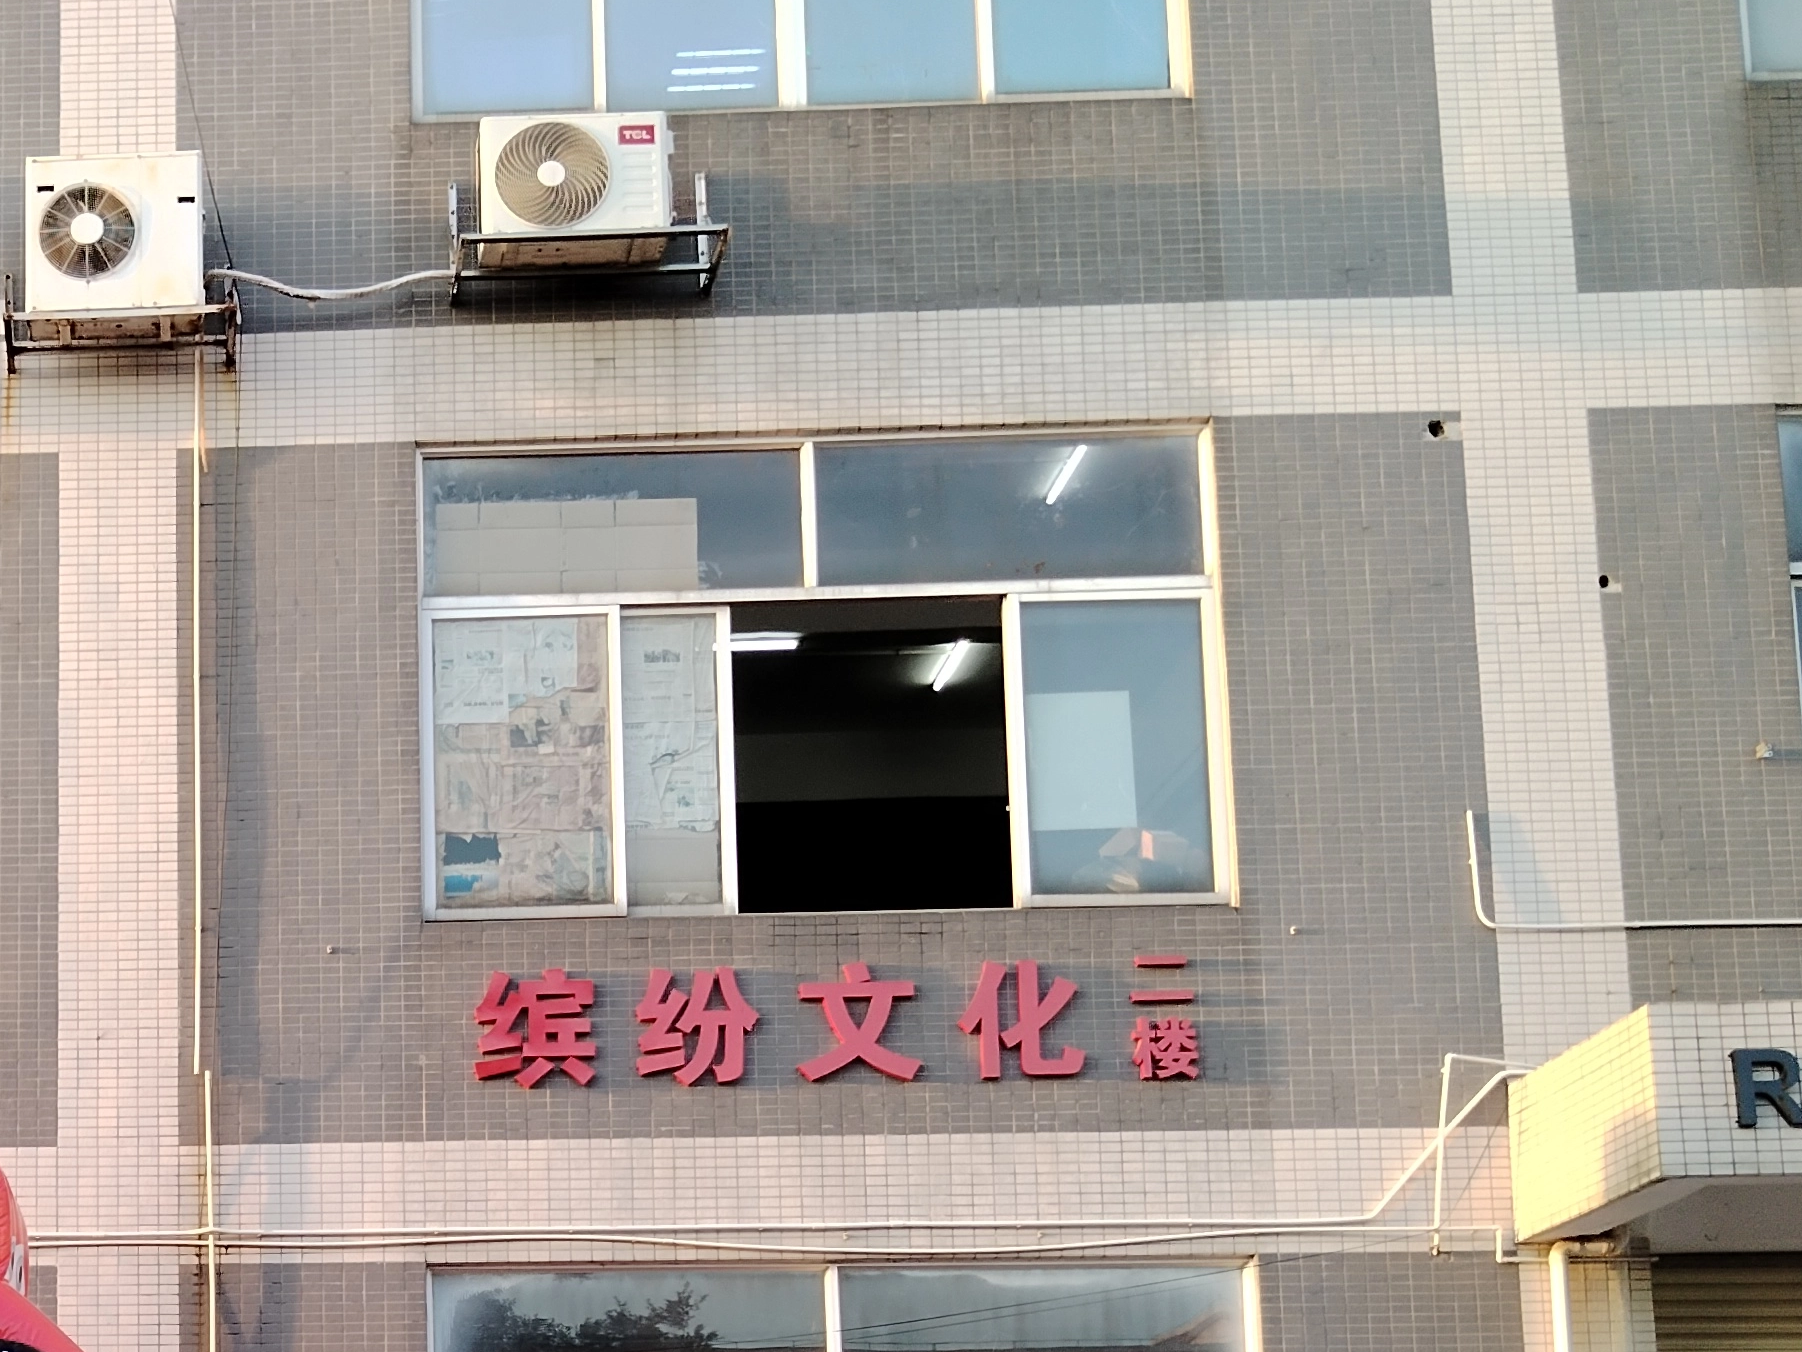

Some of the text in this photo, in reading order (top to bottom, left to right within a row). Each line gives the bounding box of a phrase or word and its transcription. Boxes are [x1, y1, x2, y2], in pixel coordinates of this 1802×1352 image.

[622, 130, 651, 140] TCL
[474, 960, 1087, 1089] 缤纷文化
[1129, 954, 1200, 1082] 二楼
